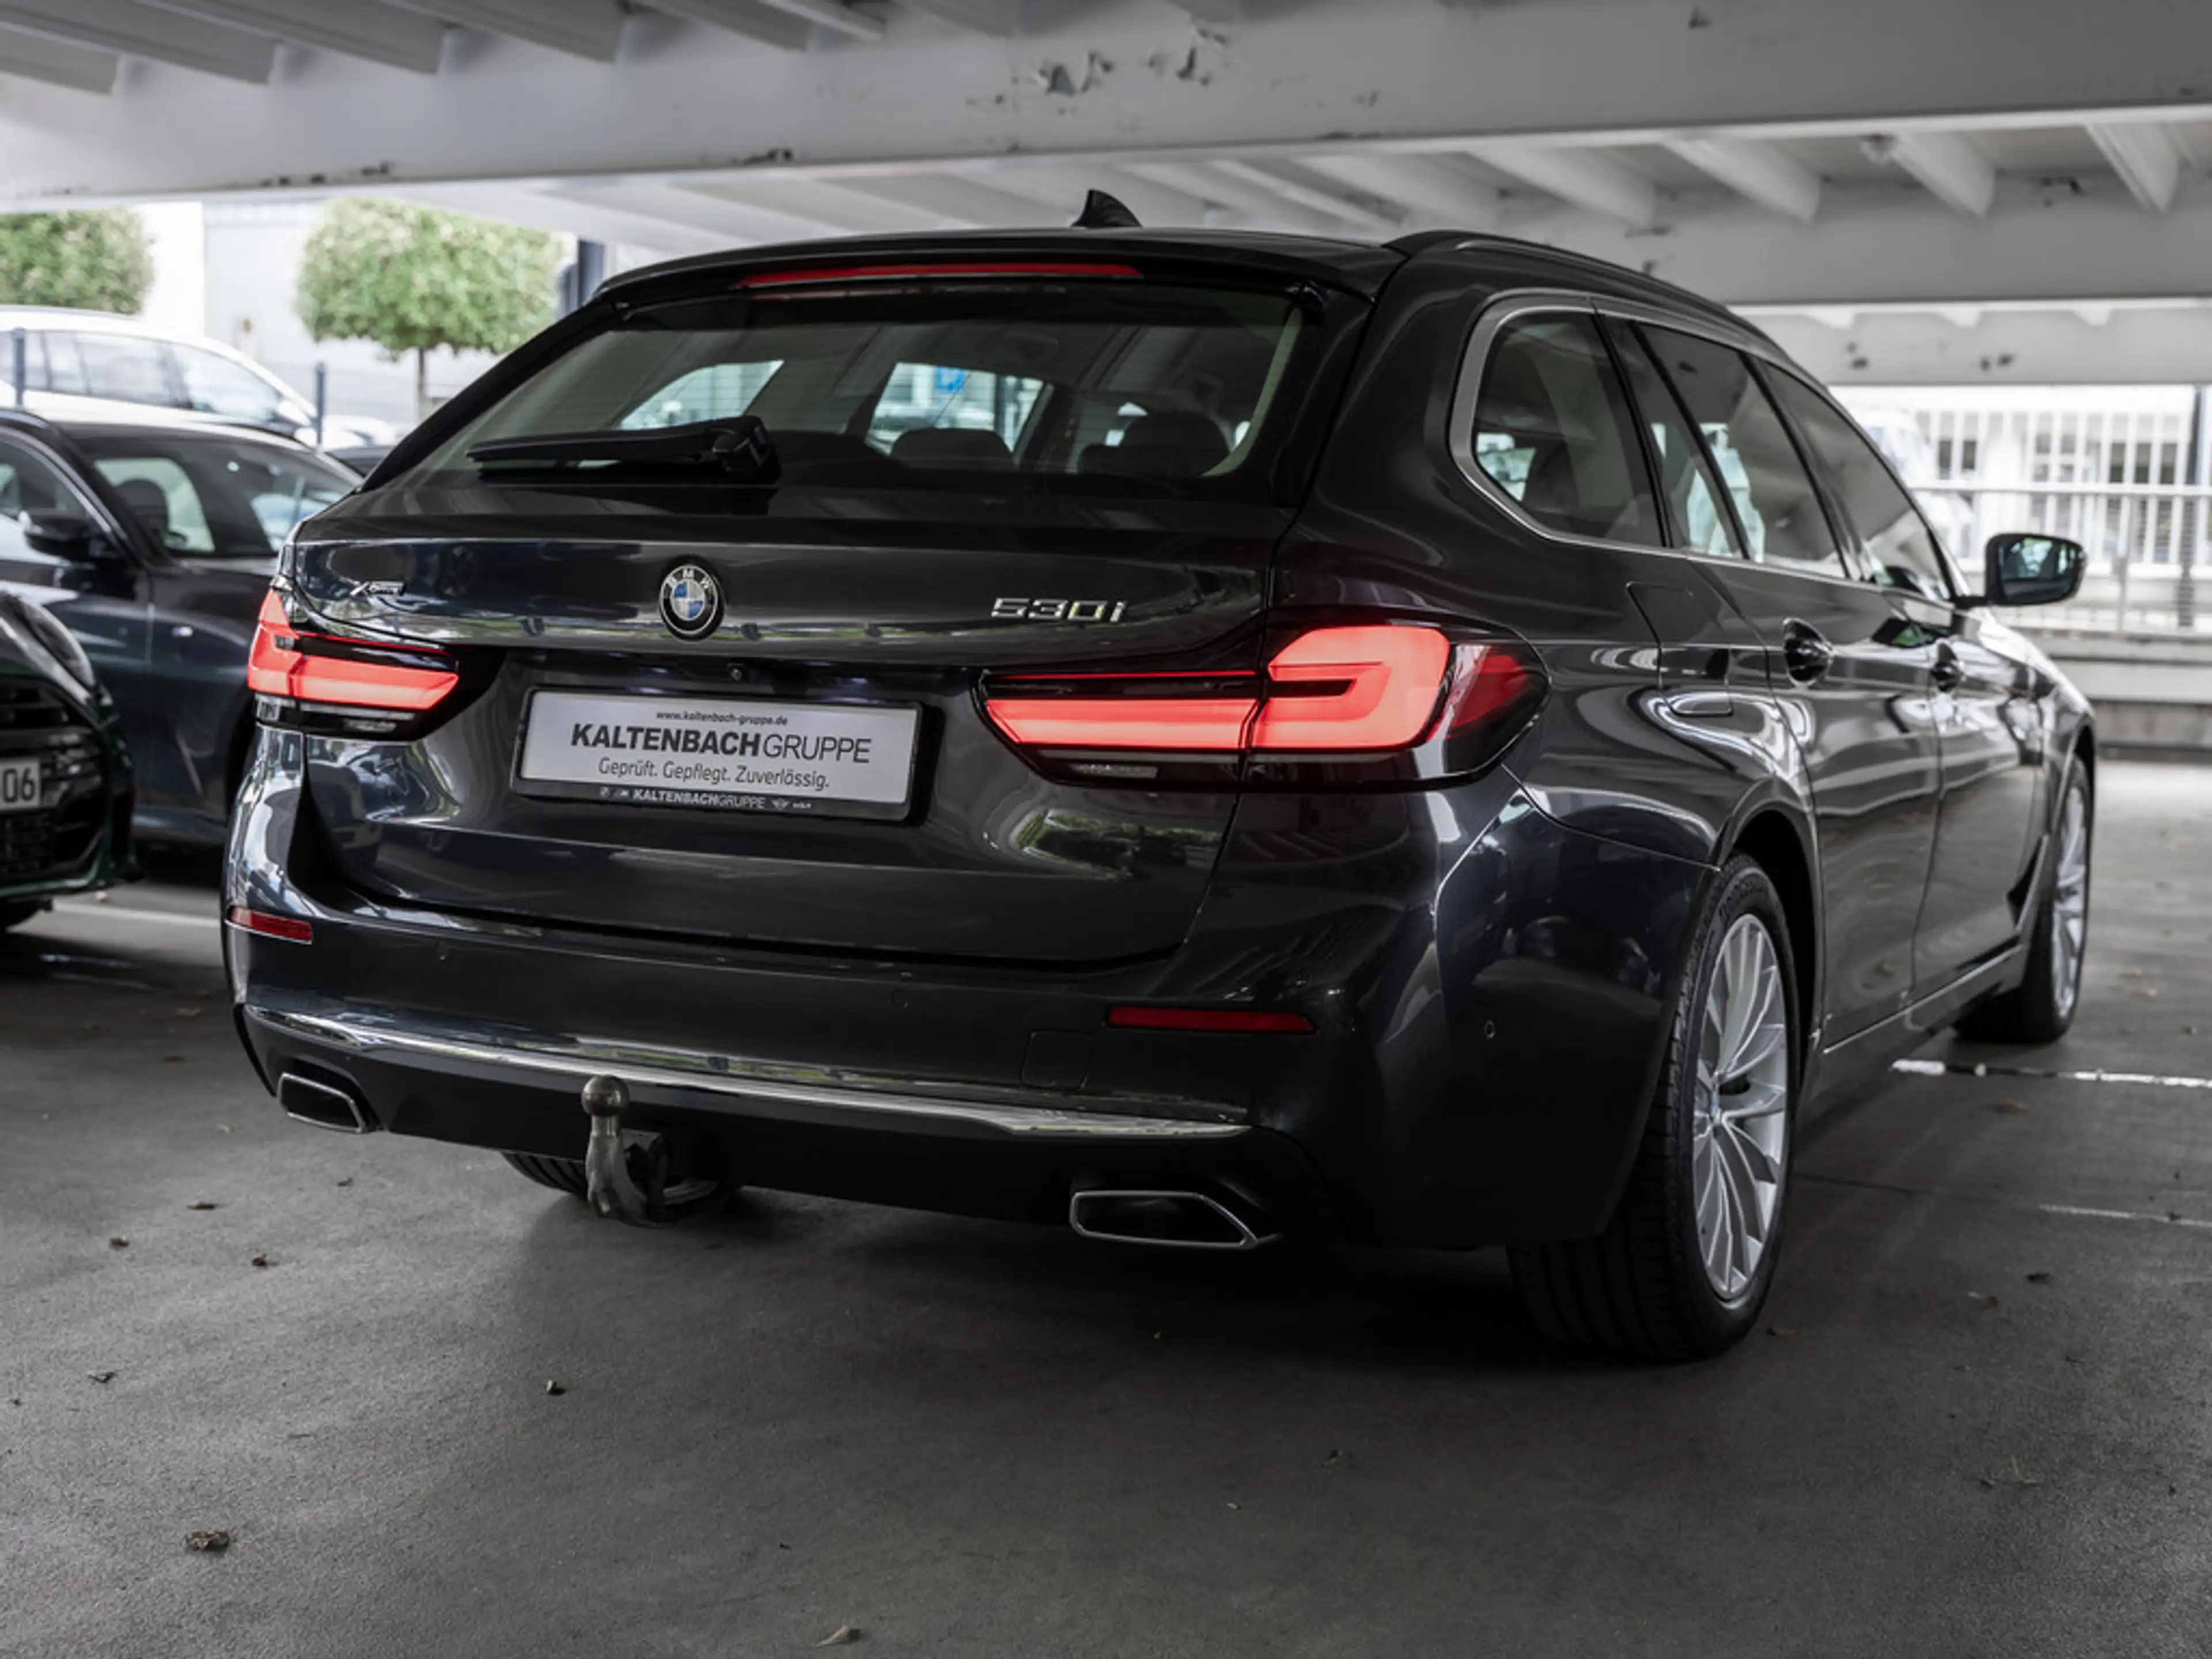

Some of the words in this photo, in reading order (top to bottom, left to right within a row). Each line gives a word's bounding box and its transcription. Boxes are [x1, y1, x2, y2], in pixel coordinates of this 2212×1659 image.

[666, 568, 713, 589] BMW
[991, 597, 1127, 623] 530i
[657, 711, 788, 726] www.kaltenbach-gruppe.de
[570, 723, 872, 764] KALTENBACHGRUPPE
[2, 767, 35, 803] 06
[598, 756, 657, 778] Geprüft.
[662, 760, 731, 785] Gepflegt.
[734, 765, 830, 791] Zuverlässig.
